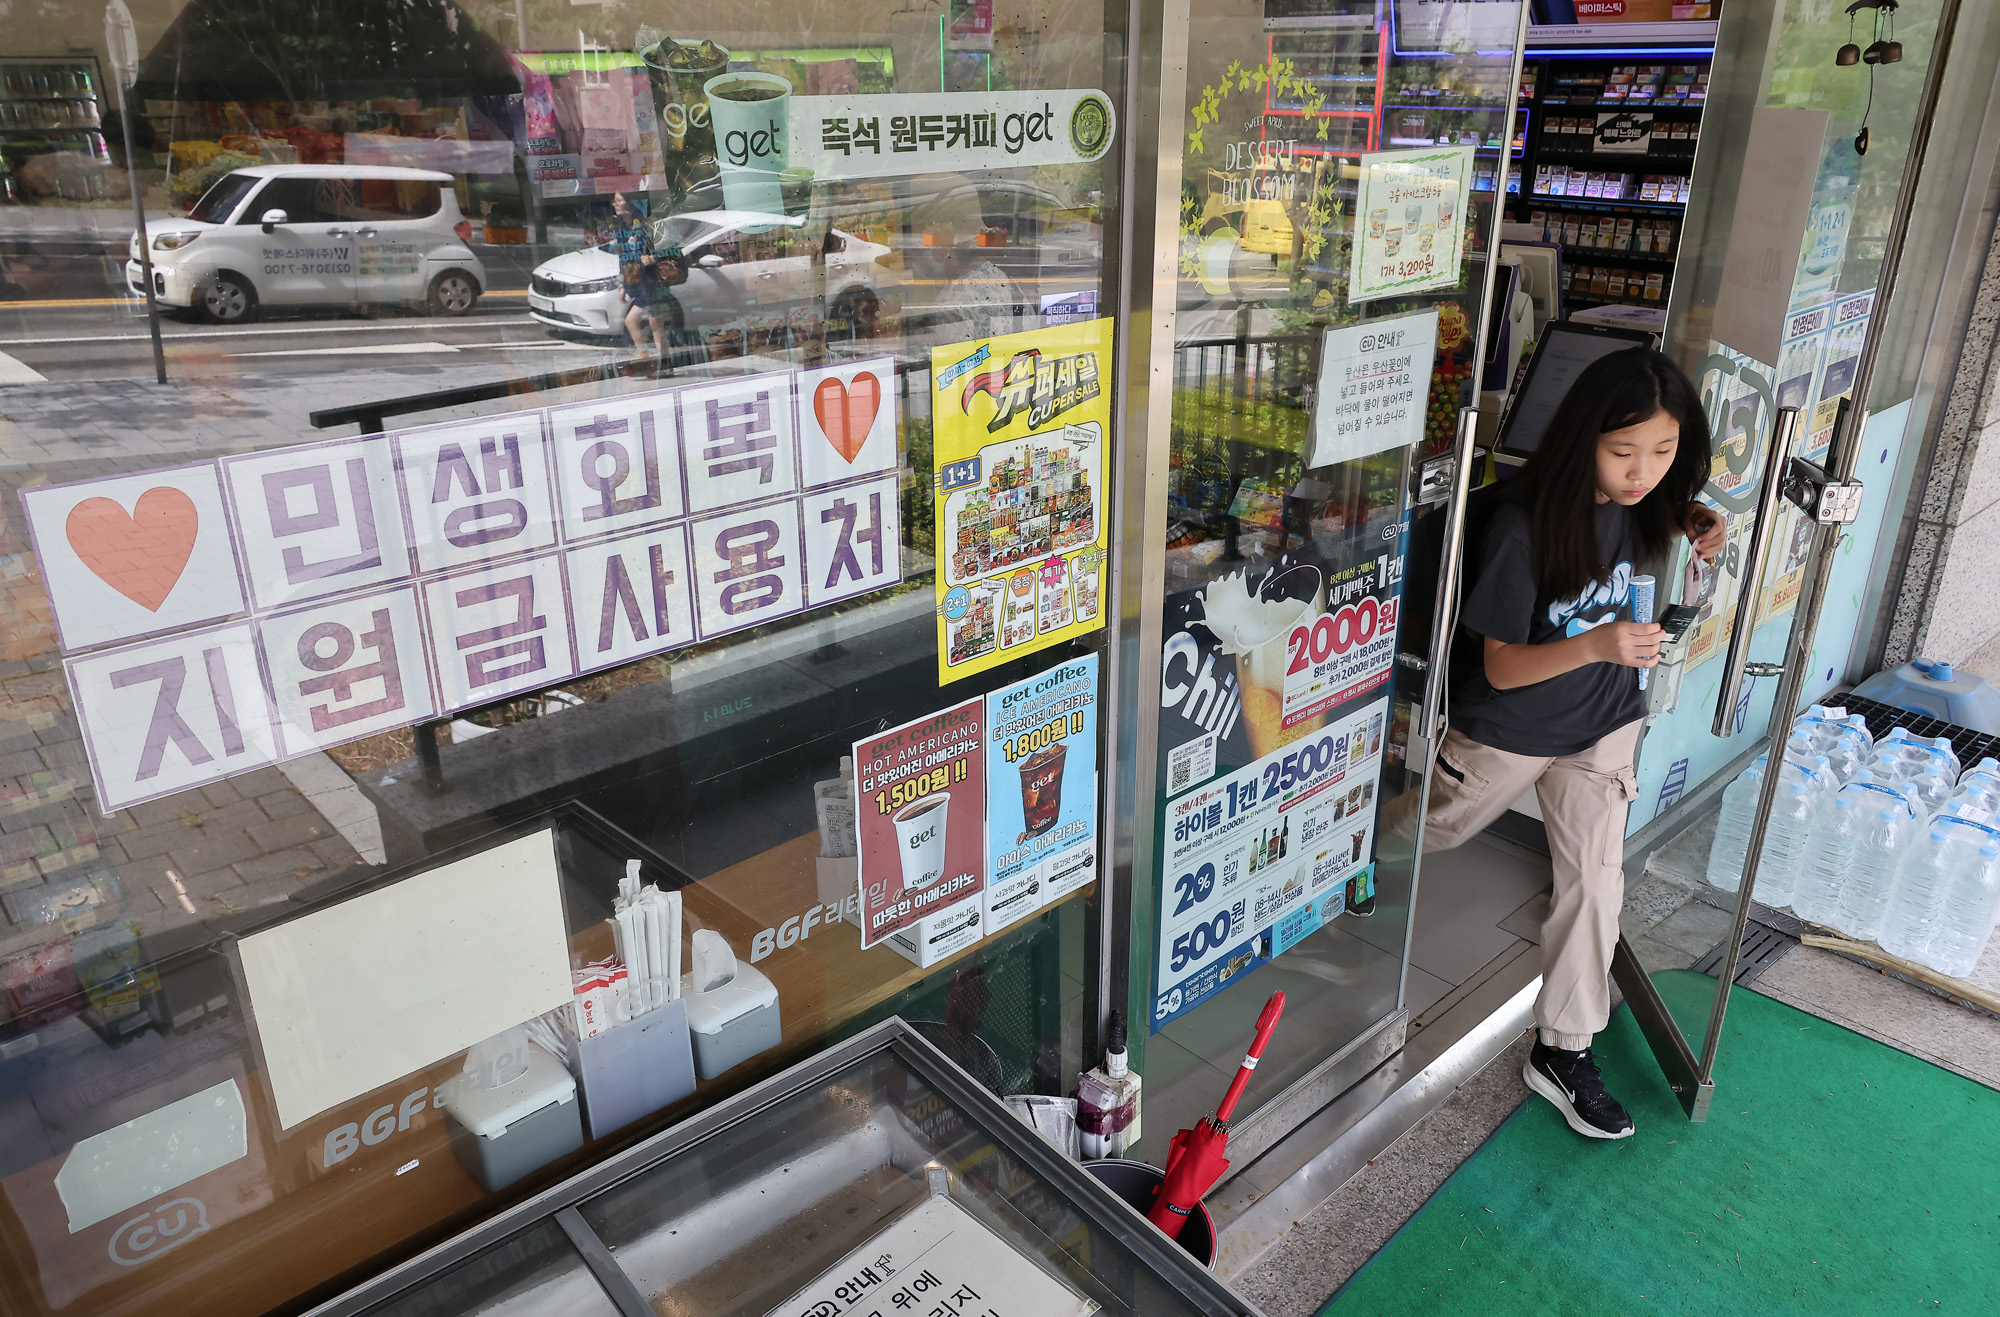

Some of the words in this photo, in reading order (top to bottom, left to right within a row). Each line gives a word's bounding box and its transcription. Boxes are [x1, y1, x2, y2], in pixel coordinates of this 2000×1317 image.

[1578, 2, 1622, 14] 베이퍼스틱
[663, 101, 710, 138] ge
[822, 116, 881, 155] 즉석
[889, 111, 997, 153] 원두커피
[1004, 102, 1054, 154] get
[1244, 116, 1265, 131] SWEET
[1268, 116, 1284, 130] APRIL
[725, 119, 781, 166] get
[1226, 139, 1298, 171] DESSERT
[1222, 173, 1297, 207] BLOSSOM
[1398, 254, 1435, 279] 3,200원
[1438, 315, 1462, 328] hupa
[1791, 309, 1824, 338] 한정판매
[1839, 296, 1869, 323] 한정판매
[1377, 331, 1396, 349] 안내
[1438, 326, 1462, 344] hups
[1345, 364, 1370, 379] 우산은
[1360, 379, 1385, 395] 들어와
[1387, 374, 1413, 389] 주세요.
[1029, 390, 1075, 427] CUPER
[1075, 381, 1099, 399] SALE
[1336, 401, 1360, 417] 바닥에
[1363, 396, 1379, 410] 물이
[1382, 389, 1413, 406] 떨어지면
[1337, 418, 1362, 435] 넘어질
[1365, 416, 1373, 427] 수
[1375, 408, 1408, 426] 있습니다.
[260, 389, 778, 587] 민생회복
[947, 461, 976, 487] 1+1
[1081, 551, 1098, 566] 3+1
[1342, 566, 1356, 580] 이상
[1327, 574, 1375, 607] 세계맥주
[1377, 554, 1405, 589] 1캔
[946, 594, 968, 613] 2+1
[1286, 597, 1397, 677] 2000원
[1313, 664, 1326, 678] 8캔
[1326, 659, 1339, 672] 이상
[1339, 653, 1352, 667] 구매
[1352, 649, 1359, 661] 시
[1359, 637, 1390, 659] 18,000원
[1002, 689, 1031, 709] get
[1035, 664, 1087, 693] coffee
[1162, 630, 1241, 741] Chill
[1328, 673, 1341, 685] 추가
[1341, 660, 1370, 682] 2,000원
[996, 707, 1017, 725] ICE
[1021, 678, 1091, 713] AMERICANO
[993, 726, 1004, 742] 더
[1005, 711, 1045, 738] 맛있어진
[1046, 692, 1094, 721] 아메리카노
[863, 755, 892, 776] HOT
[897, 721, 979, 763] AMERICANO
[872, 734, 904, 758] get
[909, 710, 971, 741] coffee
[1003, 719, 1067, 763] 1,800원
[1071, 710, 1084, 734] !!
[862, 779, 874, 793] 더
[877, 757, 922, 788] 맛있어진
[925, 738, 980, 769] 아메리카노
[875, 764, 950, 815] 1,500원
[954, 758, 968, 783] !!
[1031, 772, 1055, 792] get
[1174, 800, 1223, 842] 하이볼
[1226, 776, 1259, 819] 1캔
[1262, 732, 1350, 801] 2500원
[909, 823, 937, 849] get
[1032, 815, 1052, 830] coffee
[1301, 828, 1315, 844] 냉장
[1315, 819, 1329, 835] 안주
[1302, 816, 1316, 832] 인기
[997, 844, 1032, 870] 아이스
[1033, 820, 1088, 853] 아메리카노
[911, 868, 938, 887] coffee
[1222, 871, 1238, 888] 주류
[1223, 859, 1239, 876] 인기
[872, 902, 911, 930] 따뜻한
[914, 872, 976, 907] 아메리카노
[1170, 897, 1246, 973] 500원
[1230, 921, 1245, 938] 할인
[834, 1266, 882, 1304] 안내
[891, 1269, 943, 1311] 위에
